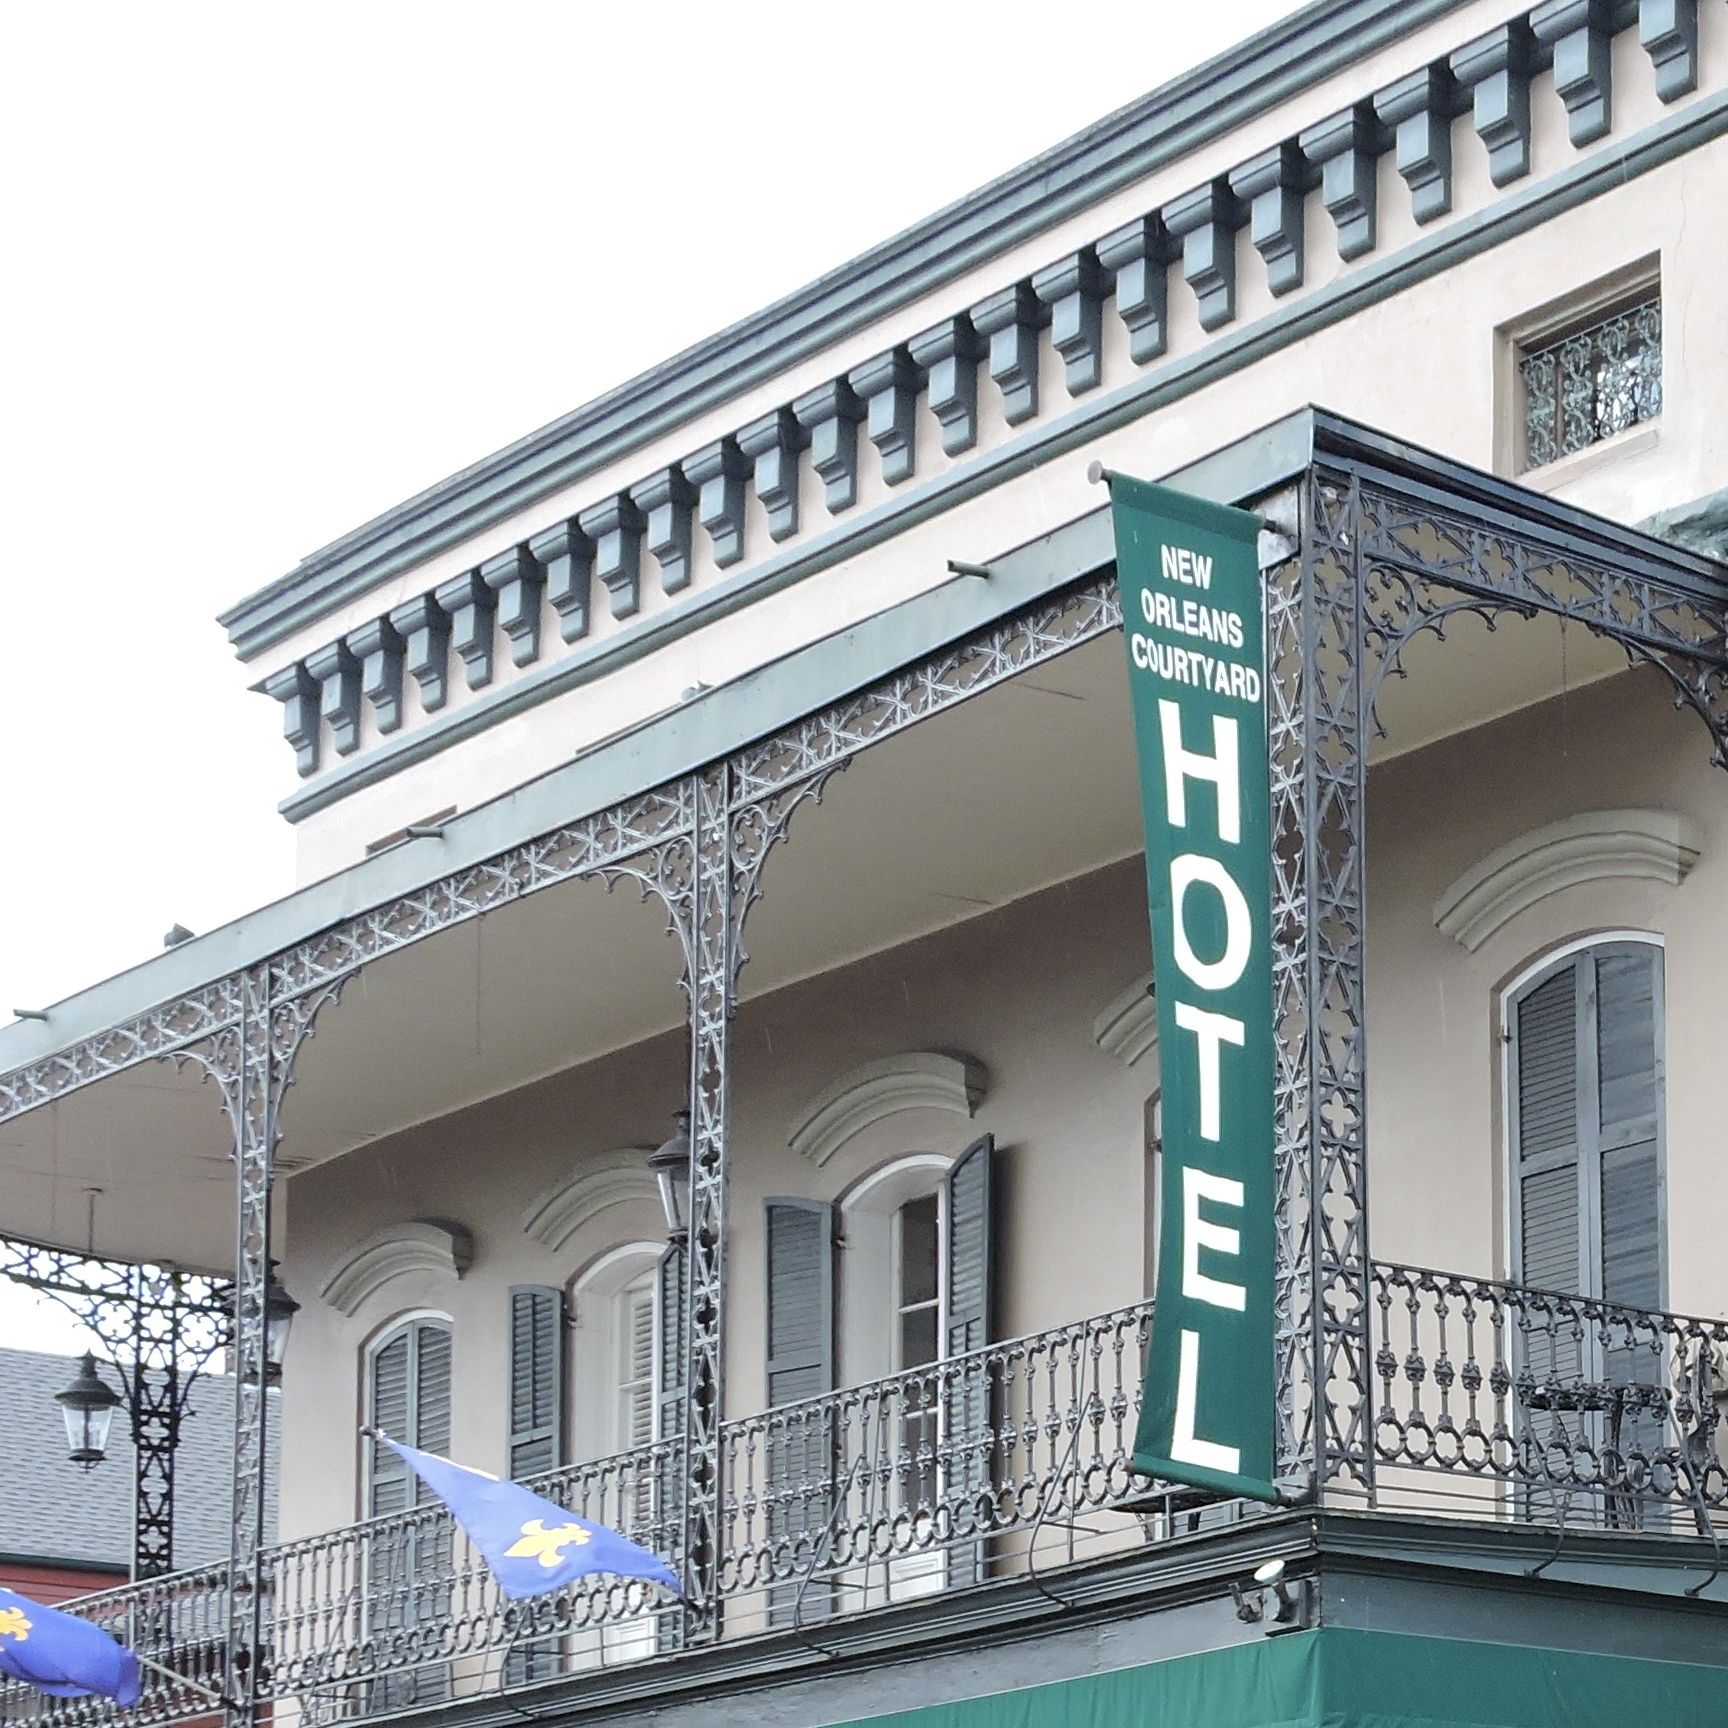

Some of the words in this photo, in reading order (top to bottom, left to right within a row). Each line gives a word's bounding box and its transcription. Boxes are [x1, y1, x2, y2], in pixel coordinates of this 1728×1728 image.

[1160, 543, 1213, 590] NEW
[1140, 587, 1244, 649] ORLEANS
[1131, 632, 1261, 703] COURTYARD
[1157, 697, 1253, 1475] HOTEL
